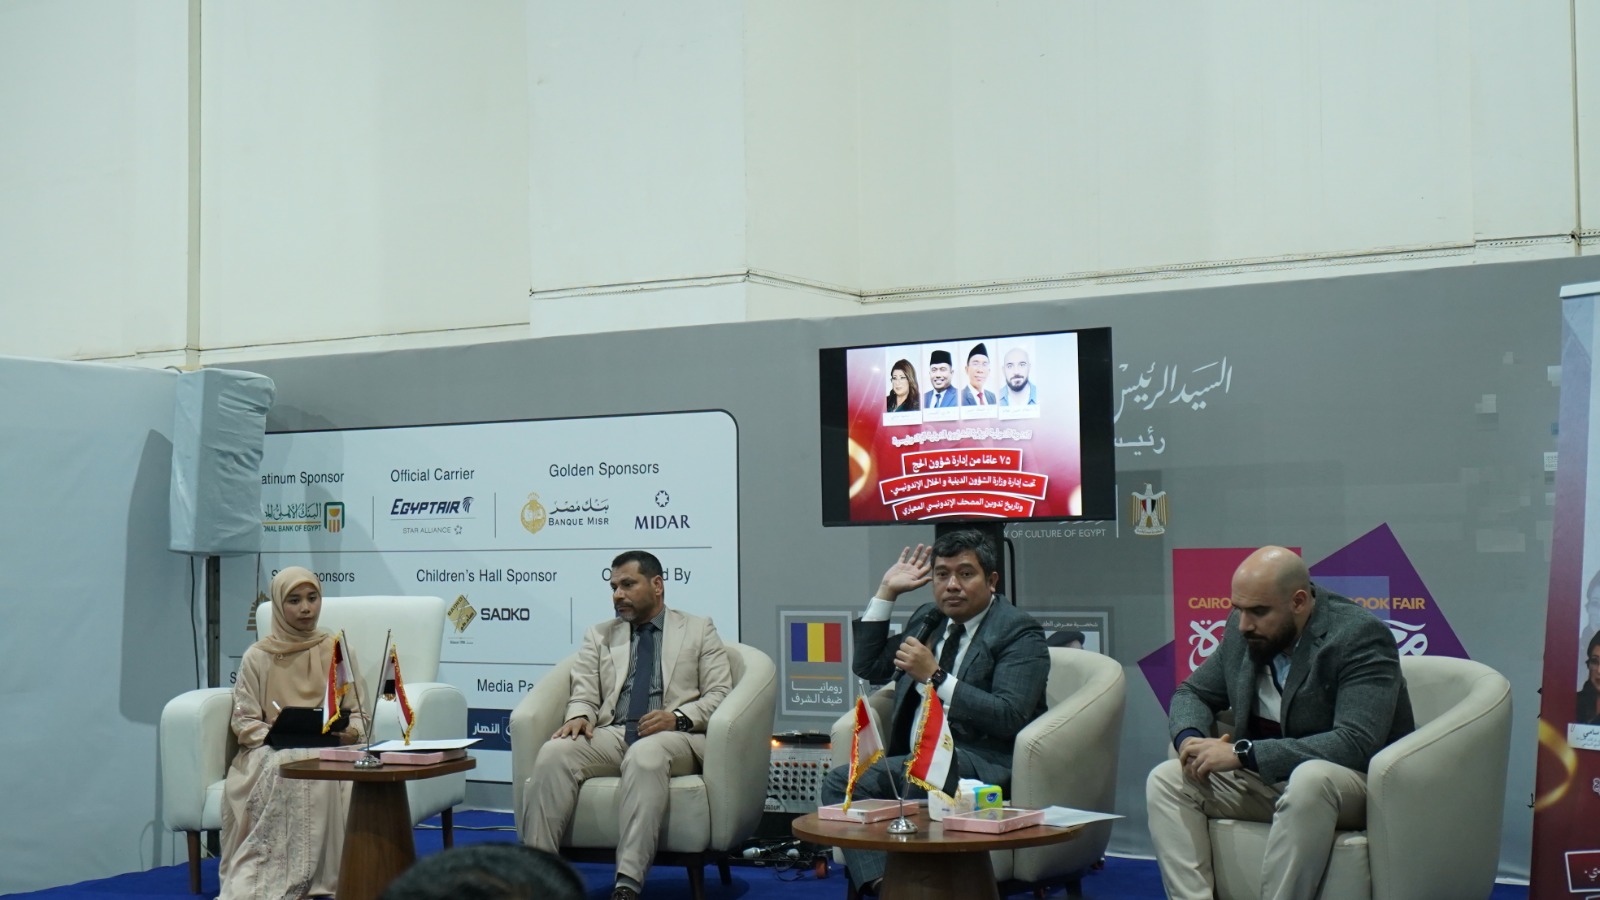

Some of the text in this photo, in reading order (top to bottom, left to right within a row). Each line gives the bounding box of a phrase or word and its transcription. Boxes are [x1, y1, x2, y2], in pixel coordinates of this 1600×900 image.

[912, 457, 928, 473] الحج
[928, 457, 951, 469] شؤون
[951, 456, 968, 467] إدارة
[969, 457, 981, 467] من
[999, 455, 1011, 465] ٧٥
[390, 468, 475, 483] Official Carrier
[549, 462, 660, 479] Golden Sponsors
[261, 471, 345, 487] atinum Sponsor
[390, 498, 460, 516] EGYPTAIR
[549, 498, 609, 515] بنك مصر
[303, 524, 322, 532] EGYPT
[634, 514, 691, 530] MIDAR
[1010, 530, 1024, 538] OF
[1024, 529, 1062, 538] CULTURE
[1064, 529, 1076, 538] OF
[1078, 528, 1106, 538] EGYPT
[313, 571, 355, 582] onsors
[479, 568, 502, 582] Hall
[506, 569, 557, 585] Sponsor
[674, 567, 691, 584] By
[1188, 597, 1233, 609] CAIRO
[1349, 597, 1426, 610] OOK FAIR
[480, 608, 530, 621] SADKO
[477, 678, 514, 692] Media
[791, 681, 843, 694] رومانيا
[791, 692, 843, 706] ضيف الشرف
[472, 722, 500, 735] النهار
